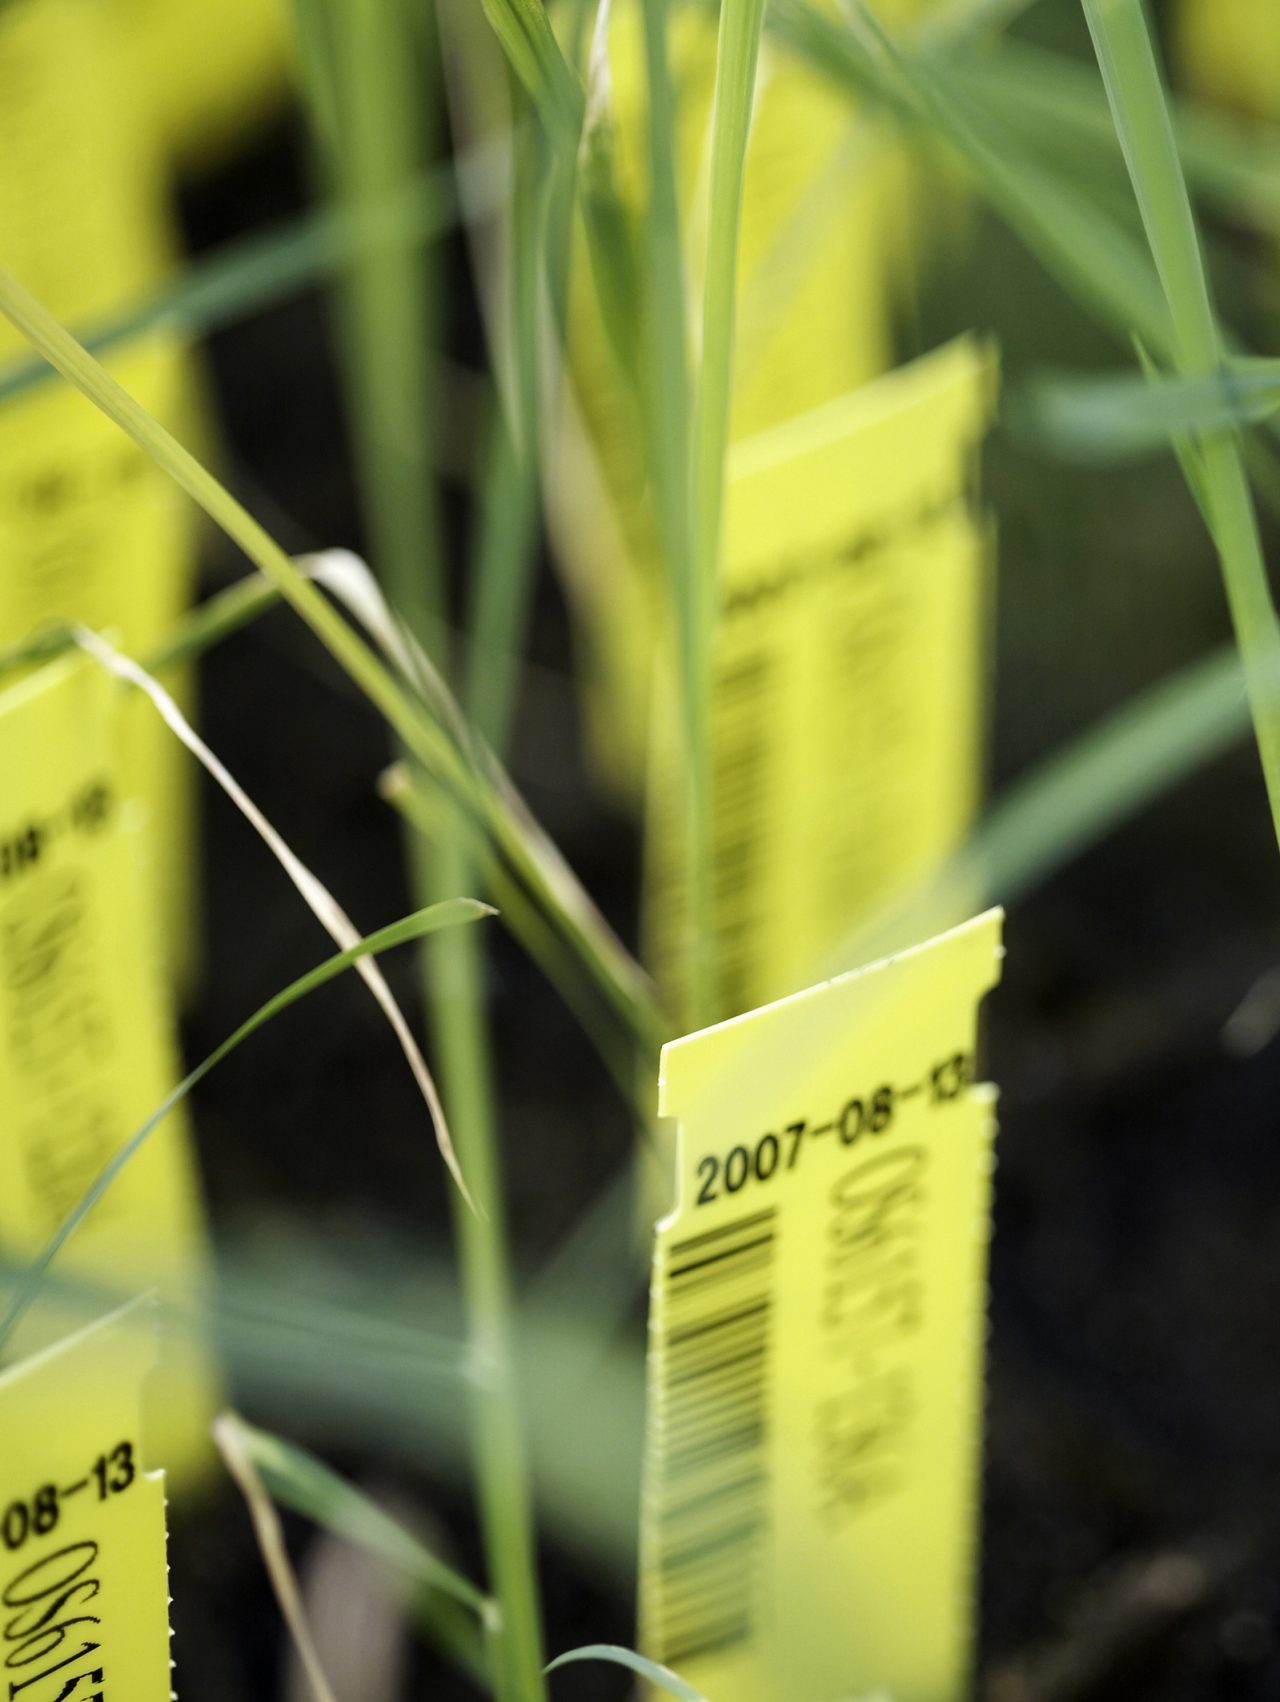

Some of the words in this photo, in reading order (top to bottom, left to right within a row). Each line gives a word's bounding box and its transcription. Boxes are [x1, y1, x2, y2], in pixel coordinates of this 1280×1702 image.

[696, 1052, 972, 1206] 2007-08-13
[3, 1440, 136, 1548] 08-13
[2, 1540, 105, 1702] OS615
